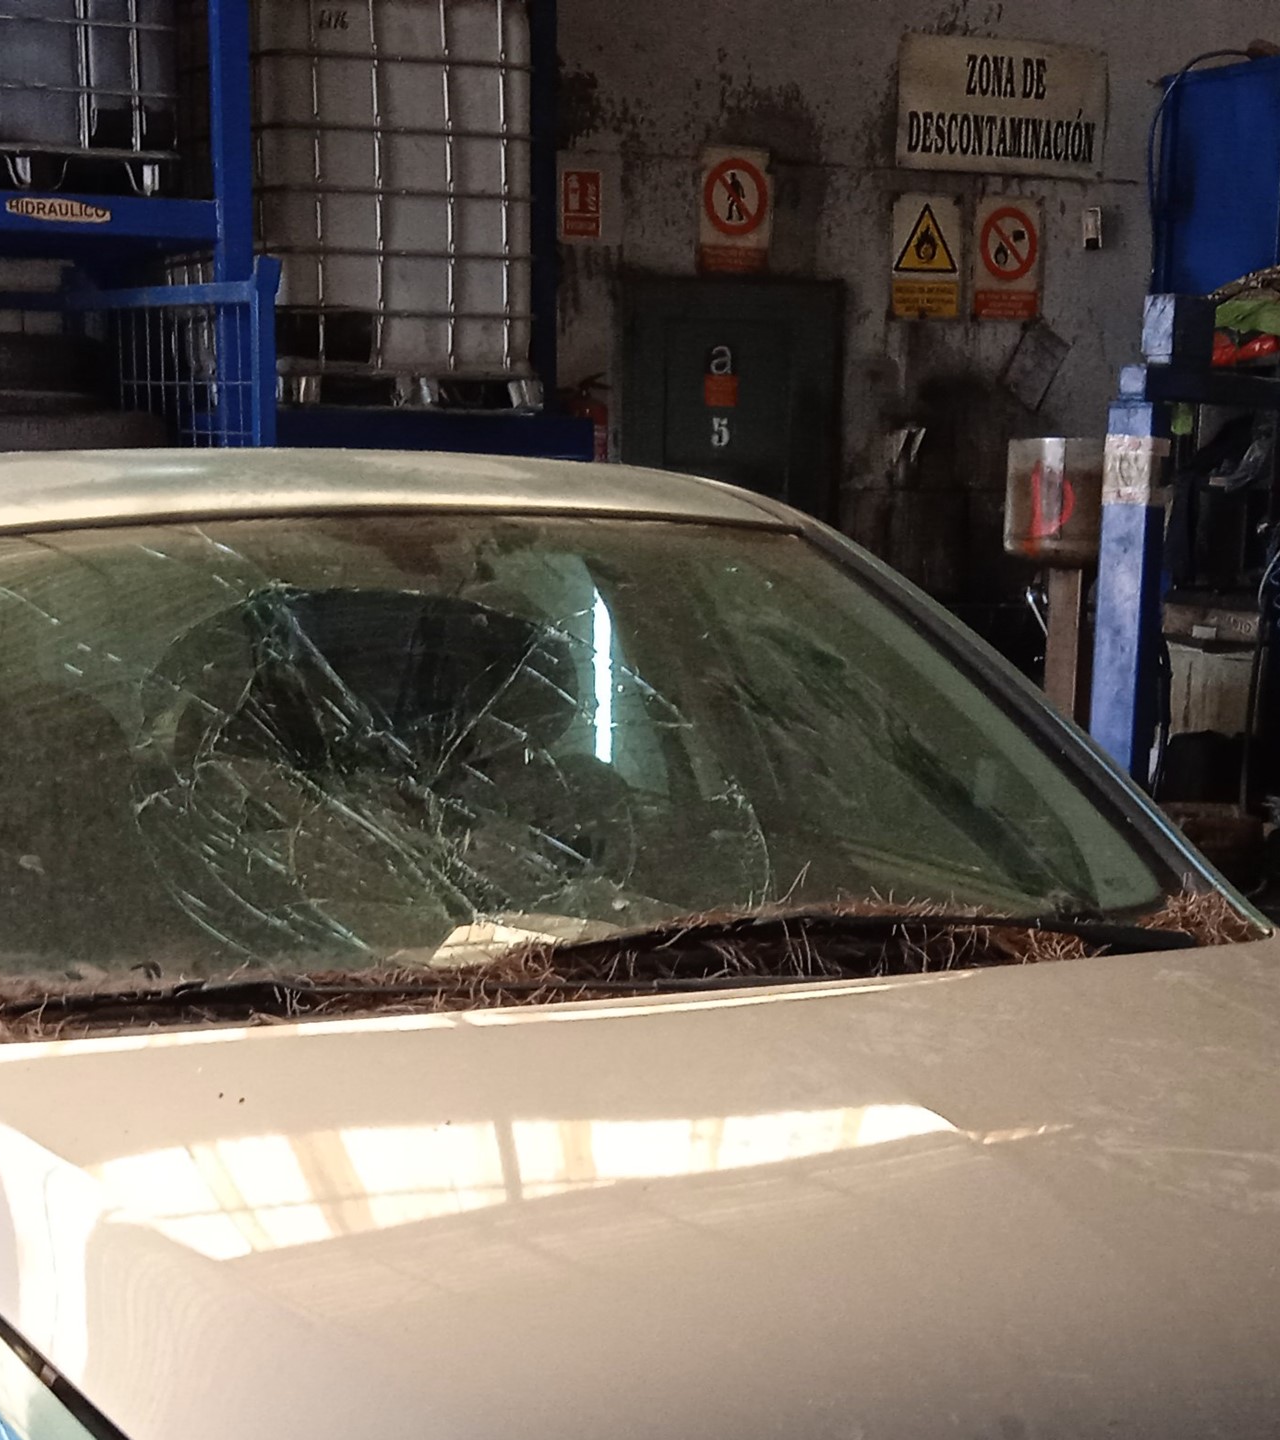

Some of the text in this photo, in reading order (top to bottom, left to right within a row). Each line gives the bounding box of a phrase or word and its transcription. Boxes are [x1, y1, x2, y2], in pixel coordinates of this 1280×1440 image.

[965, 54, 1047, 100] ZONA DE
[907, 107, 1096, 163] DESCONTAMINACIÓN
[9, 200, 107, 218] HIDRAULICO
[711, 417, 730, 447] 5
